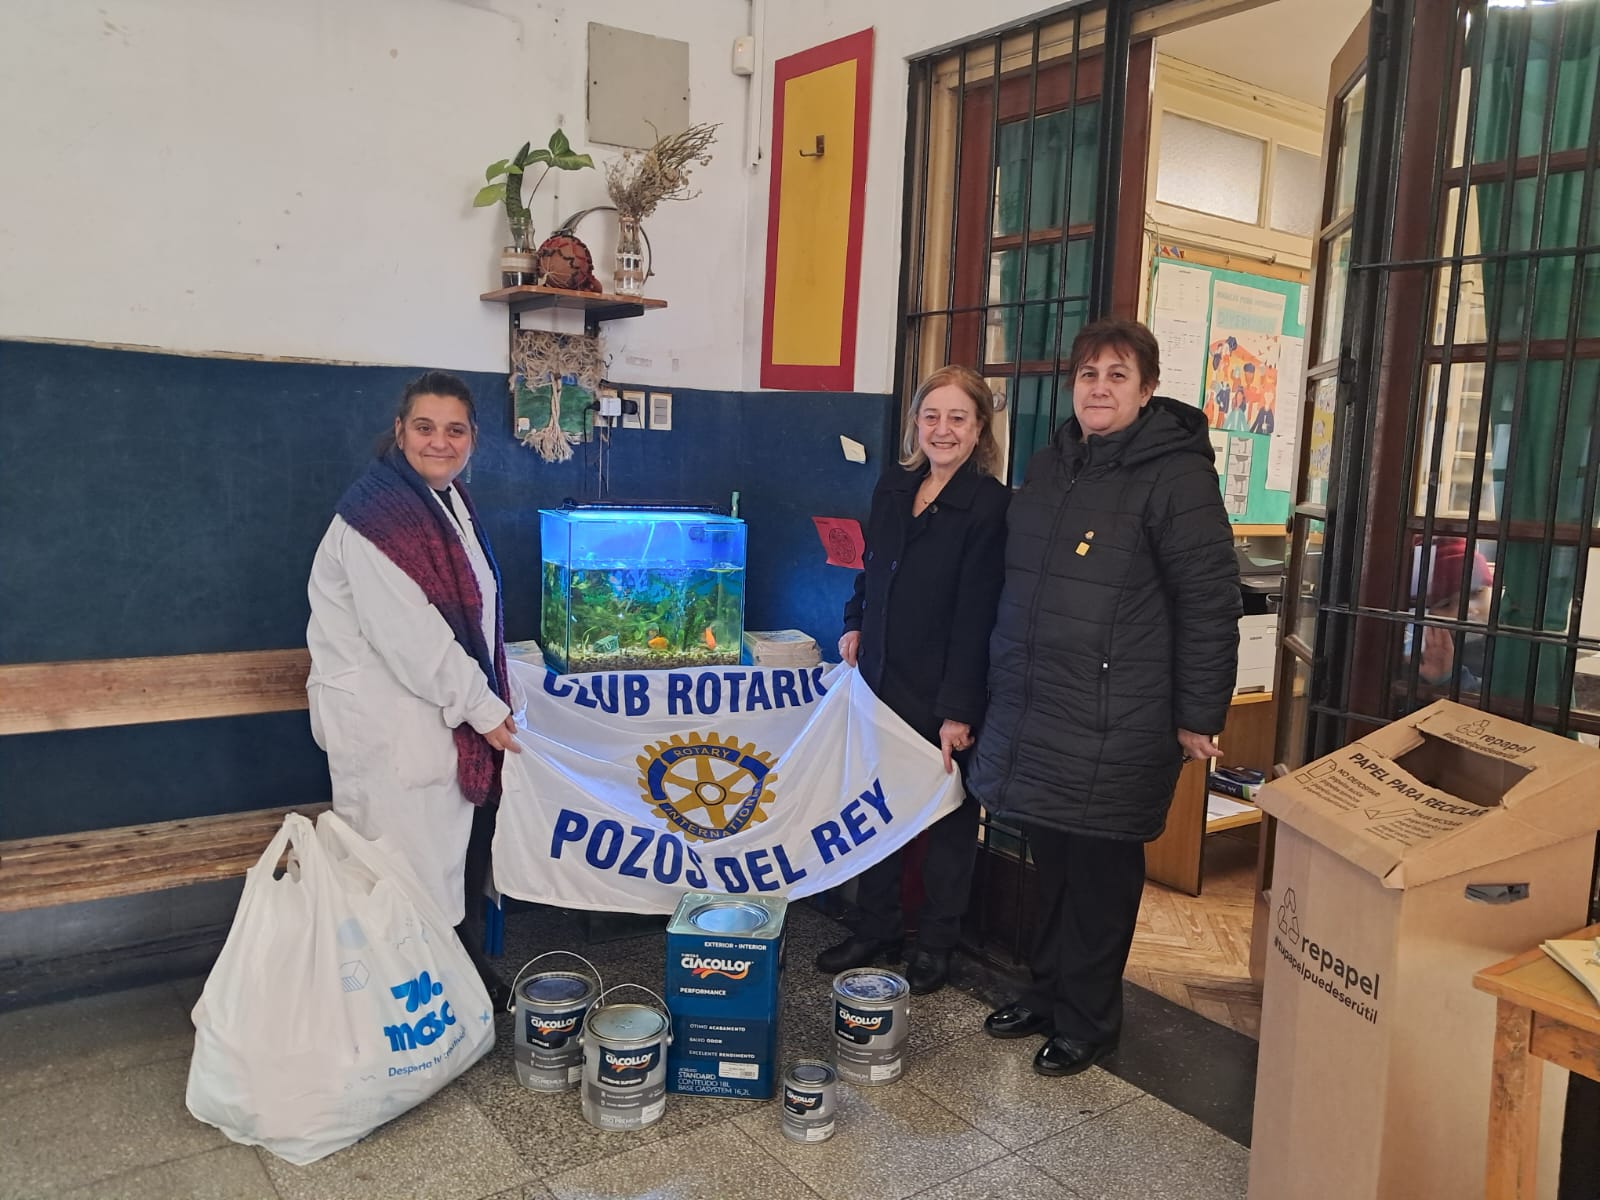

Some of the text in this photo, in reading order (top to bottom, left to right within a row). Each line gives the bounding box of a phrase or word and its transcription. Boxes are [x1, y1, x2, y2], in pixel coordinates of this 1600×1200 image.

[543, 672, 650, 716] CLUB
[673, 747, 731, 760] ROTARY
[1479, 733, 1536, 754] repapel
[1349, 752, 1390, 782] PAPEL
[1386, 778, 1424, 801] PARA
[1421, 797, 1490, 817] RECICLAR
[550, 777, 894, 894] POZOS DEL REY
[704, 941, 767, 951] EXTERIOR INTERIOR
[1301, 936, 1380, 1001] repapel
[1273, 935, 1378, 1025] #tupapelpuedeserútil
[680, 987, 727, 996] PERFORMANCE
[689, 1050, 718, 1058] EXCELENTE
[678, 1071, 716, 1080] STANDARD
